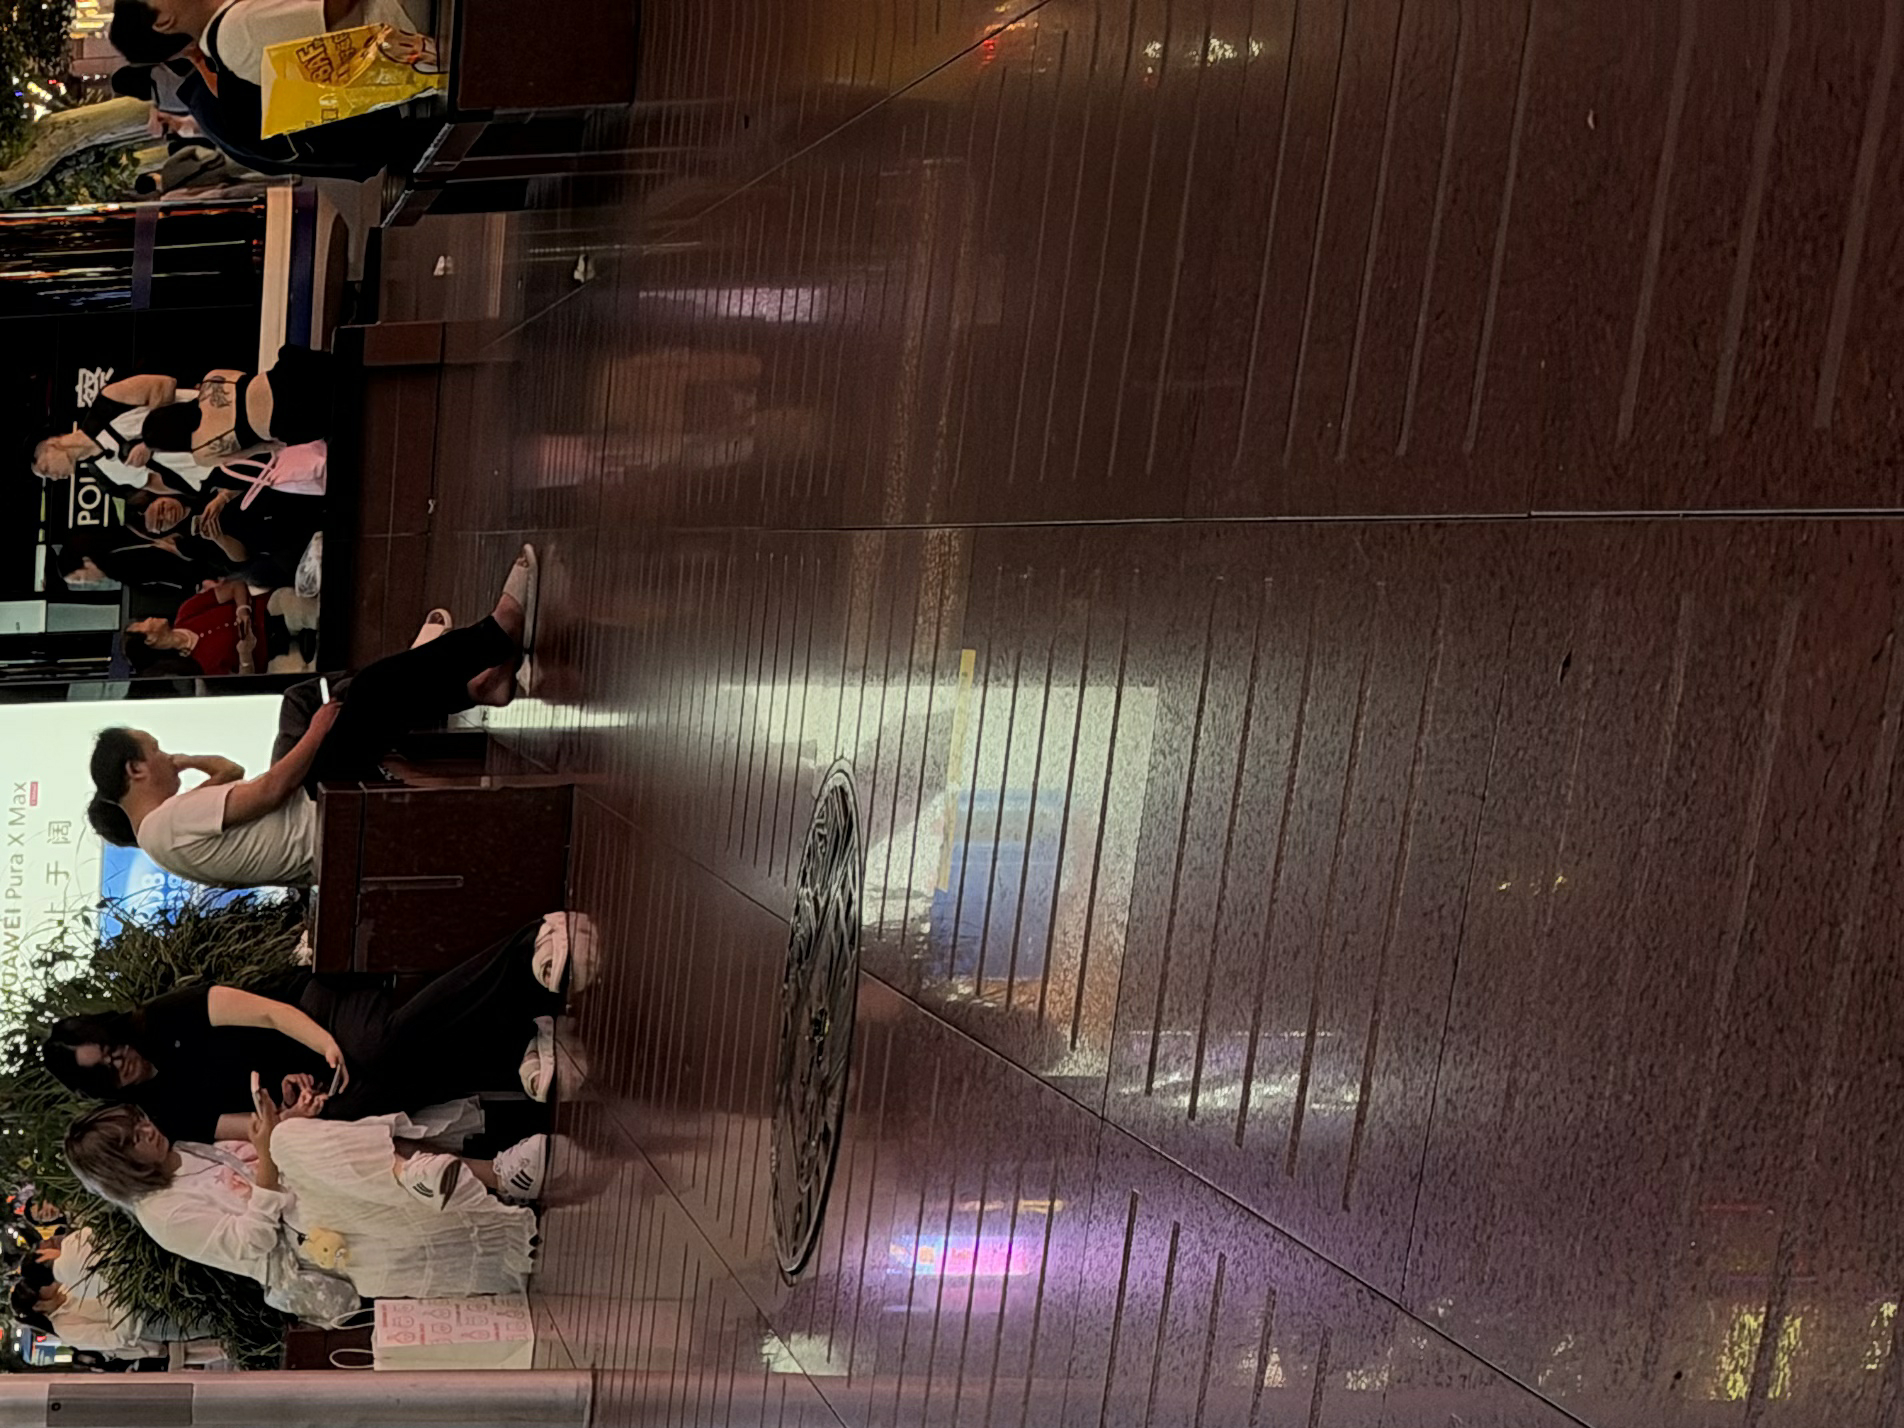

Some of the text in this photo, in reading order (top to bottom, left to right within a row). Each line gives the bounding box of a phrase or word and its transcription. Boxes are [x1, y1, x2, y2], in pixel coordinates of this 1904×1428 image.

[8, 781, 28, 826] Max
[7, 832, 25, 847] X
[4, 853, 24, 900] Pura
